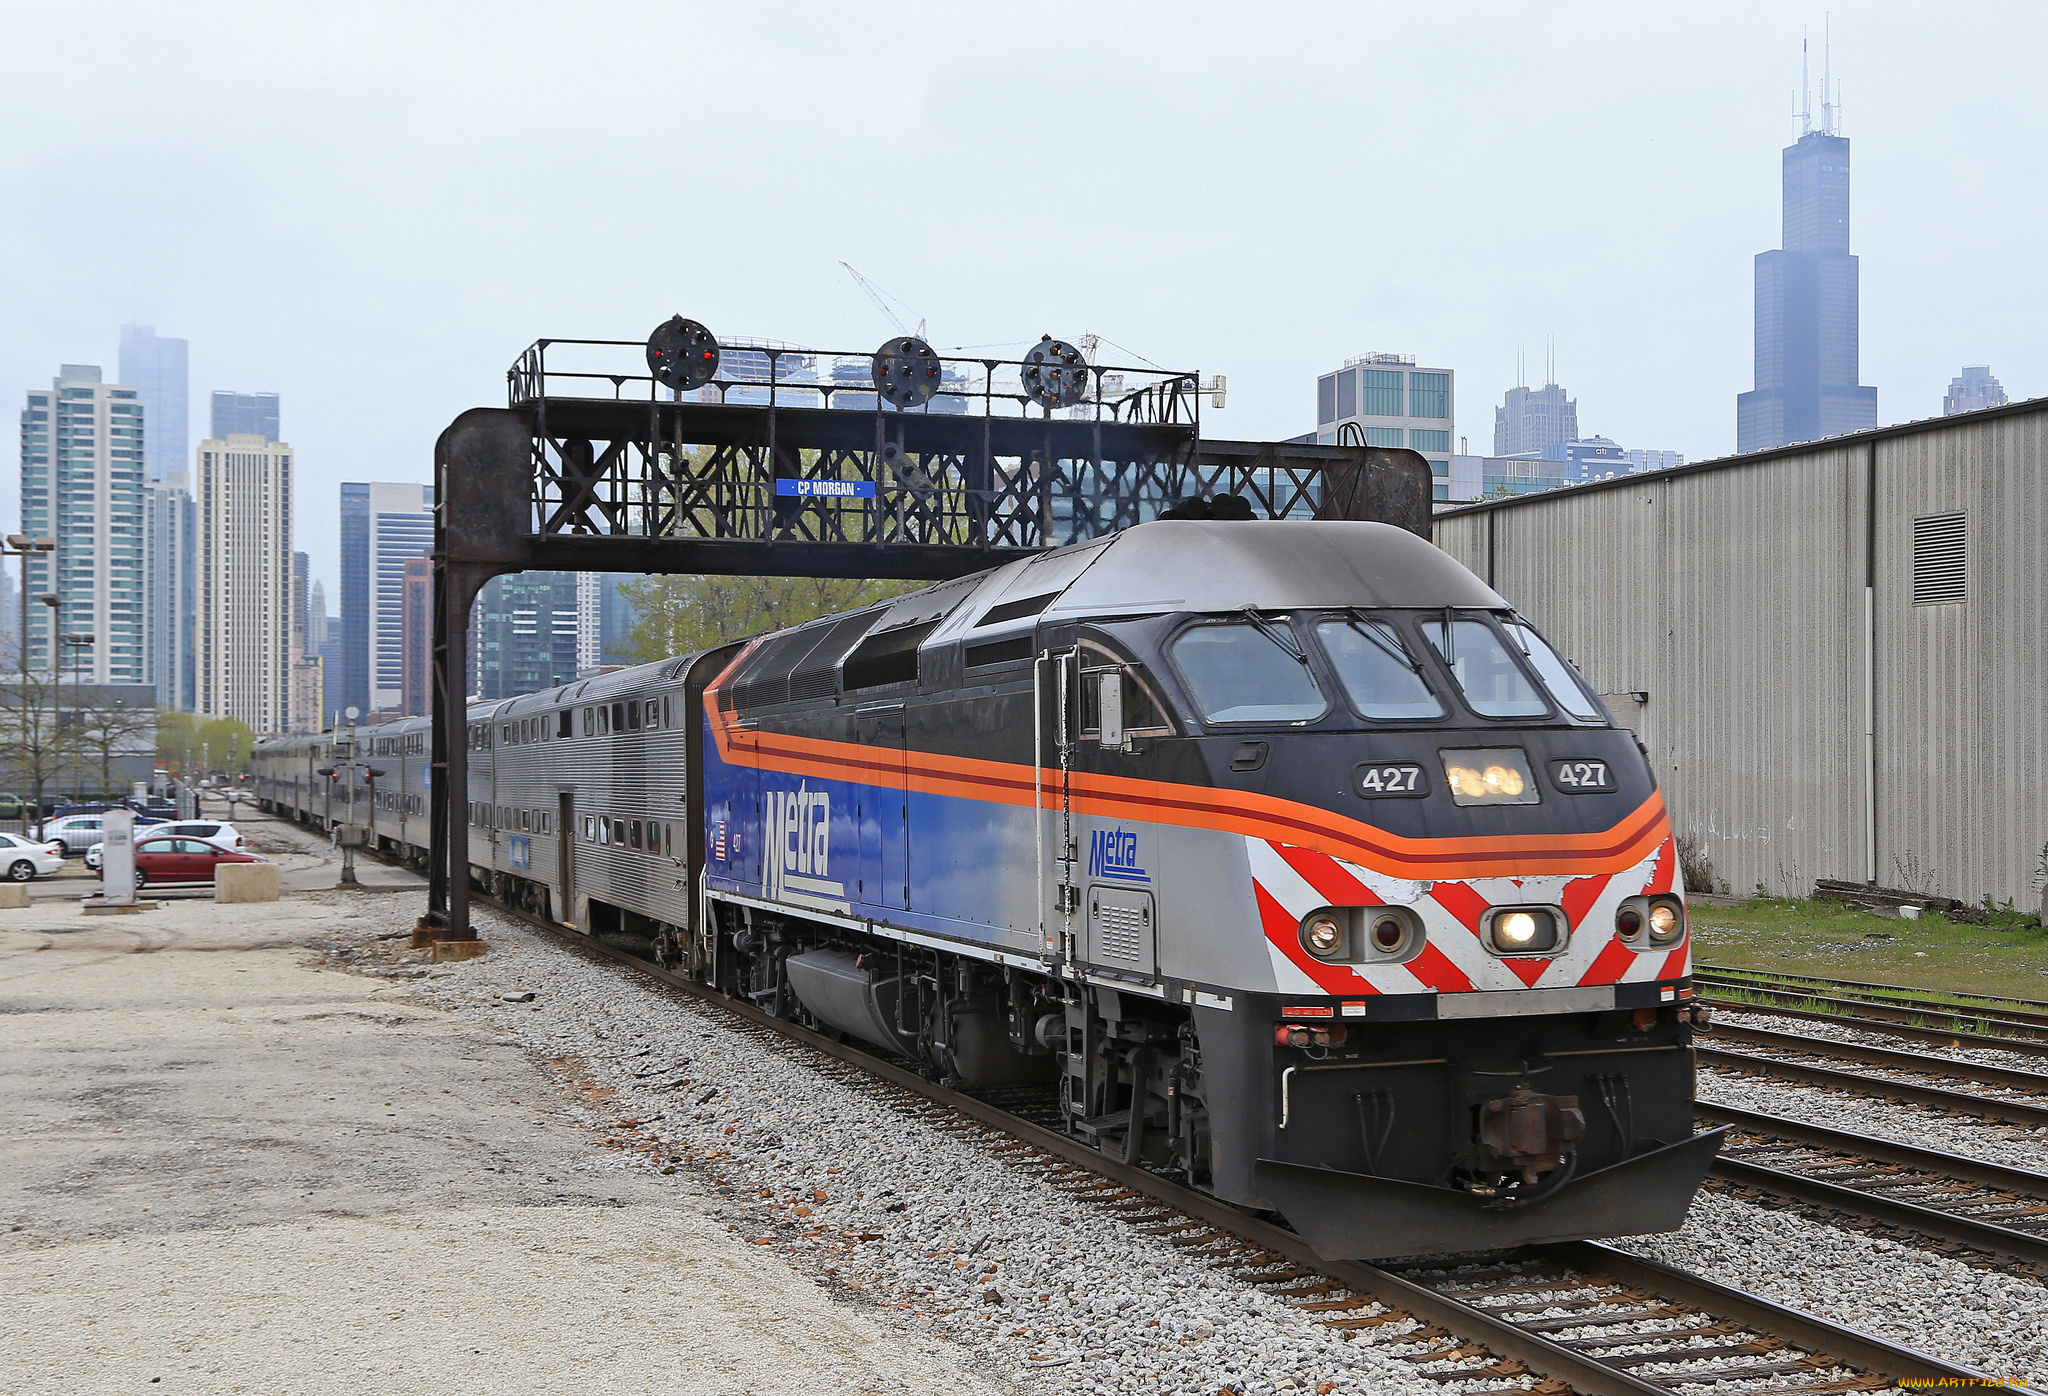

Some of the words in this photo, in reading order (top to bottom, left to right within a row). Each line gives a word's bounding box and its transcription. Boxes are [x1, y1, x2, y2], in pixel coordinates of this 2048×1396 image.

[797, 481, 810, 495] CP
[812, 481, 854, 496] MORGAN
[1362, 767, 1419, 792] 427
[1558, 763, 1606, 787] 427
[762, 779, 832, 900] Metra
[1089, 826, 1138, 878] Metra
